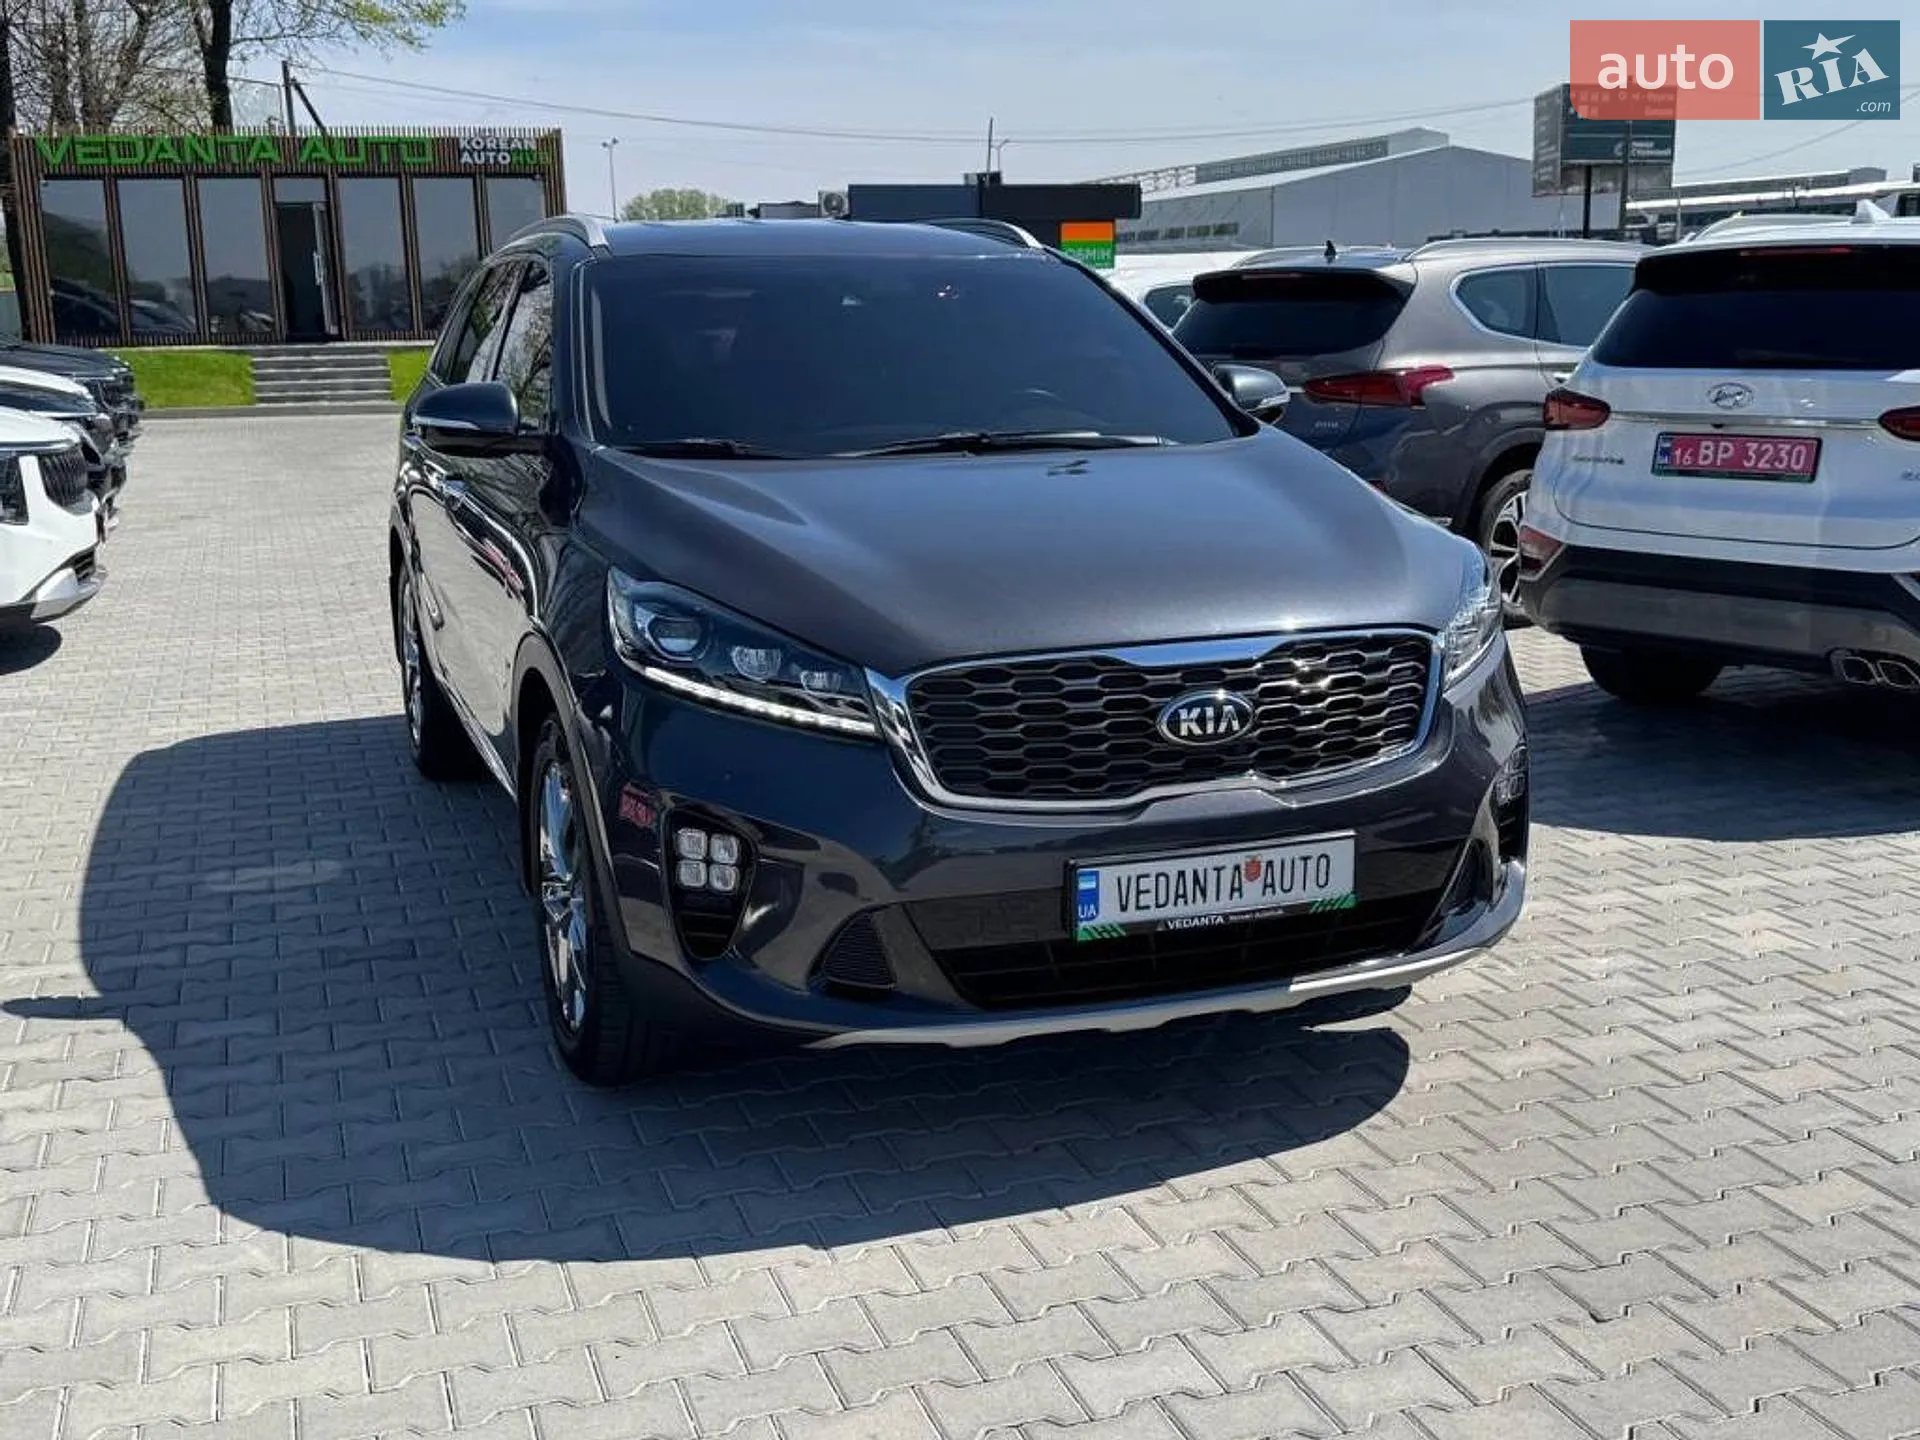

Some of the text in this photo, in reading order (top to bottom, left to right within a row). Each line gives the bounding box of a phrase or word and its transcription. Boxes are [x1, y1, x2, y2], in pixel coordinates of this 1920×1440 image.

[35, 134, 432, 165] VEDANTA AUTO
[460, 136, 537, 150] KOREAN
[1674, 448, 1693, 466] 16
[1698, 440, 1735, 467] BP
[1742, 442, 1808, 470] 3230
[1178, 704, 1241, 737] KIA
[1117, 853, 1331, 912] VEDANTA AUTO
[1078, 903, 1096, 919] UA
[1168, 915, 1224, 930] VEDANTA
